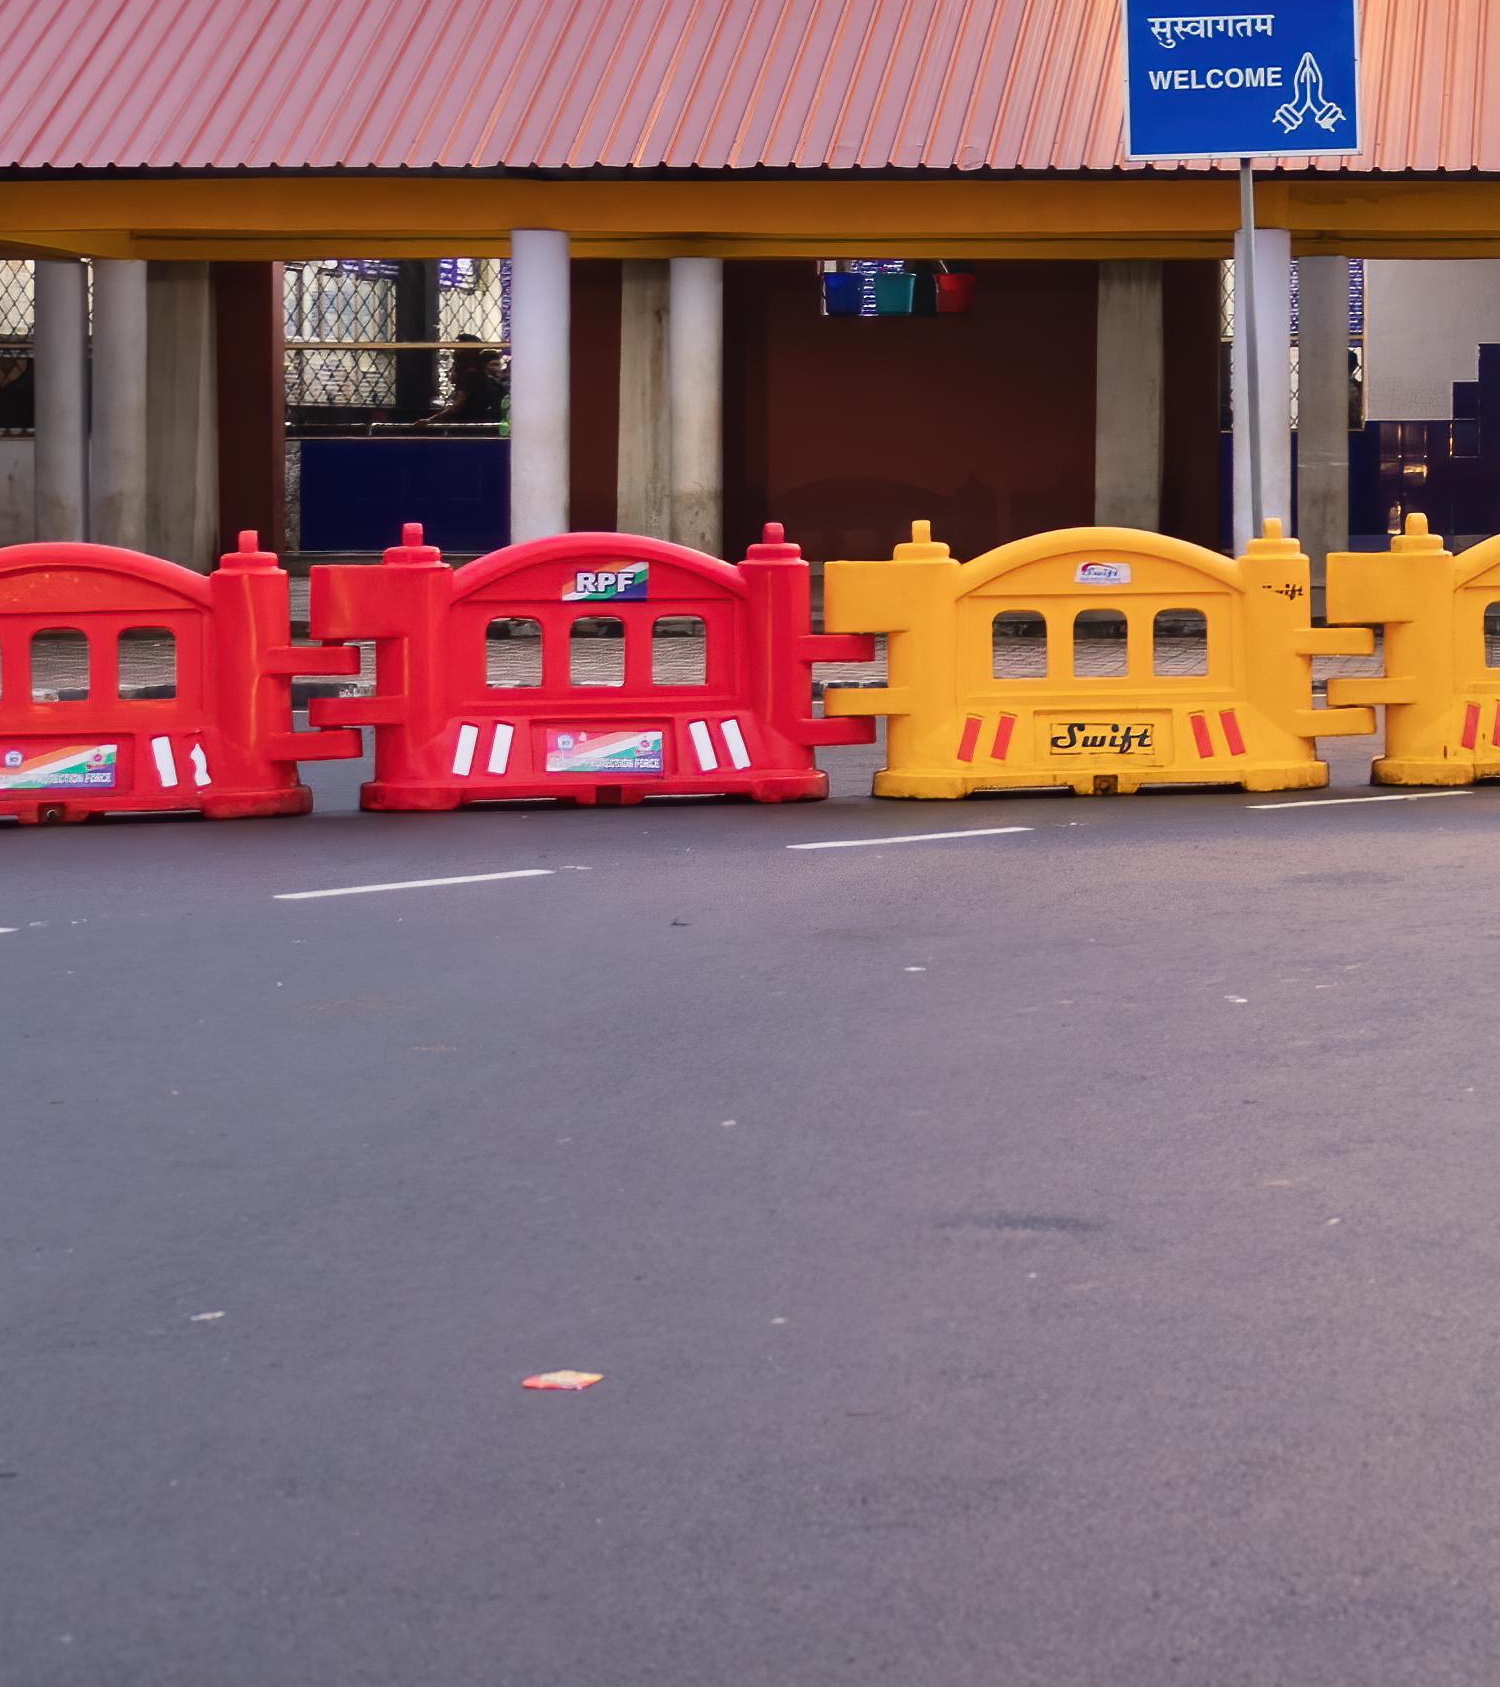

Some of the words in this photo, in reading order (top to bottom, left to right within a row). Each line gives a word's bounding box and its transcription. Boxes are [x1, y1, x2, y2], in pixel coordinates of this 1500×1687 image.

[1147, 14, 1275, 49] सुस्वागतम
[1148, 67, 1283, 90] WELCOME
[576, 572, 635, 593] RPF
[1050, 722, 1153, 754] Swift
